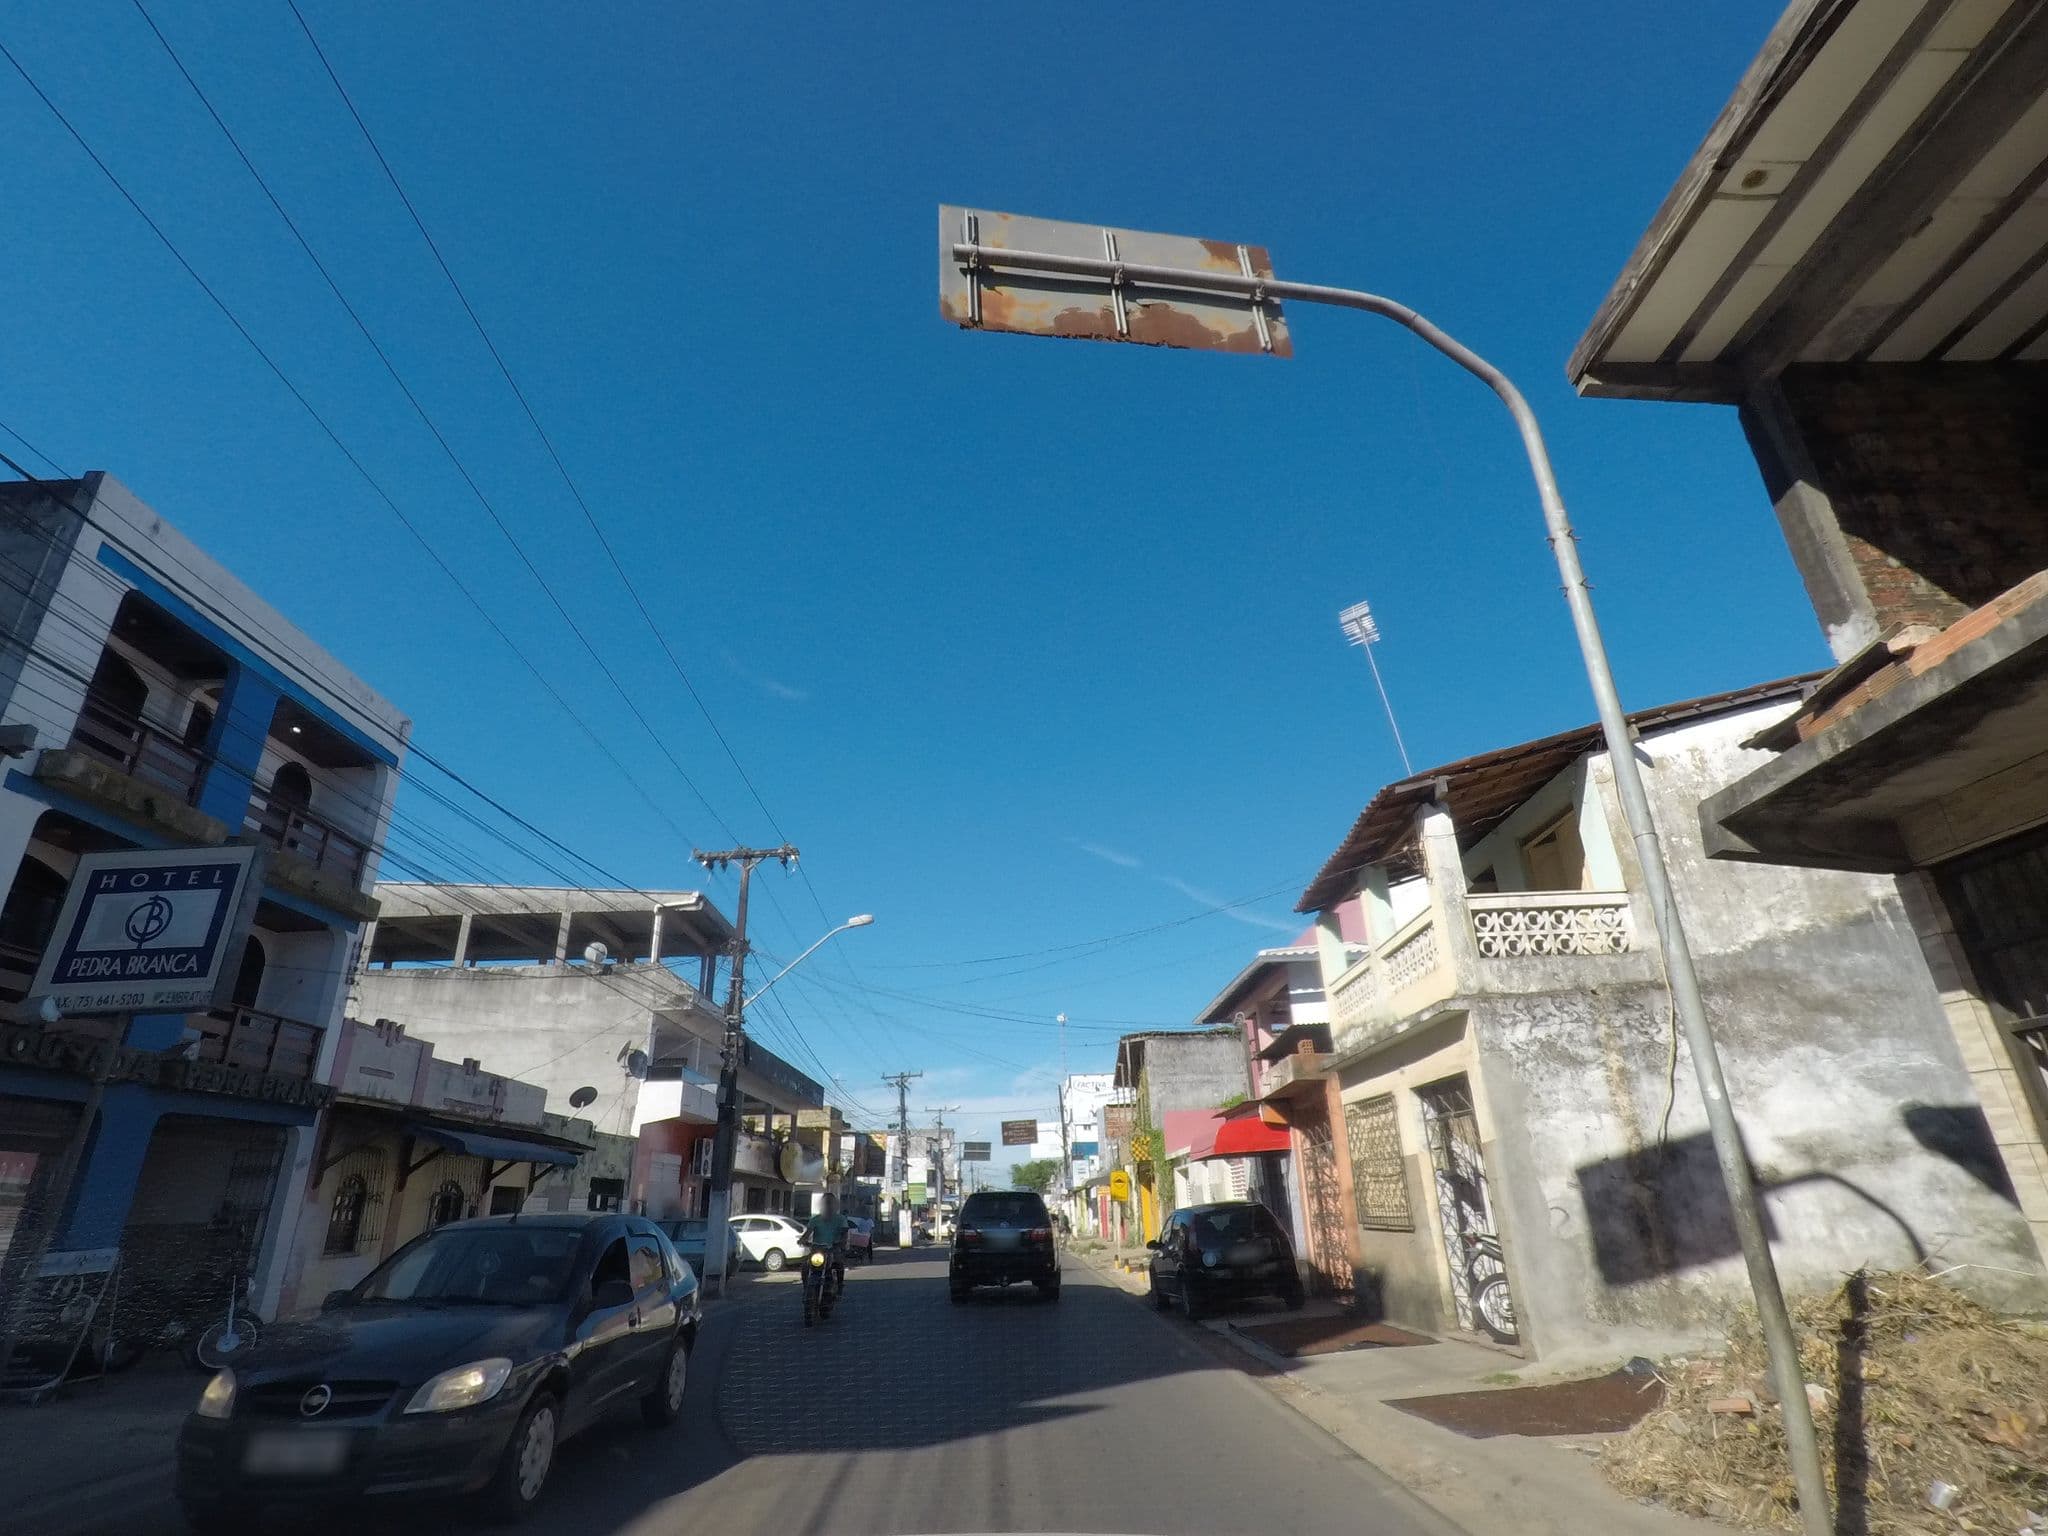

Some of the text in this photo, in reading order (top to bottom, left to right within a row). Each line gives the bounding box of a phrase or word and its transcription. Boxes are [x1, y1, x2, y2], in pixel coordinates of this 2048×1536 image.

[99, 868, 224, 889] HOTEL
[67, 953, 199, 978] PEDRA BRANCA
